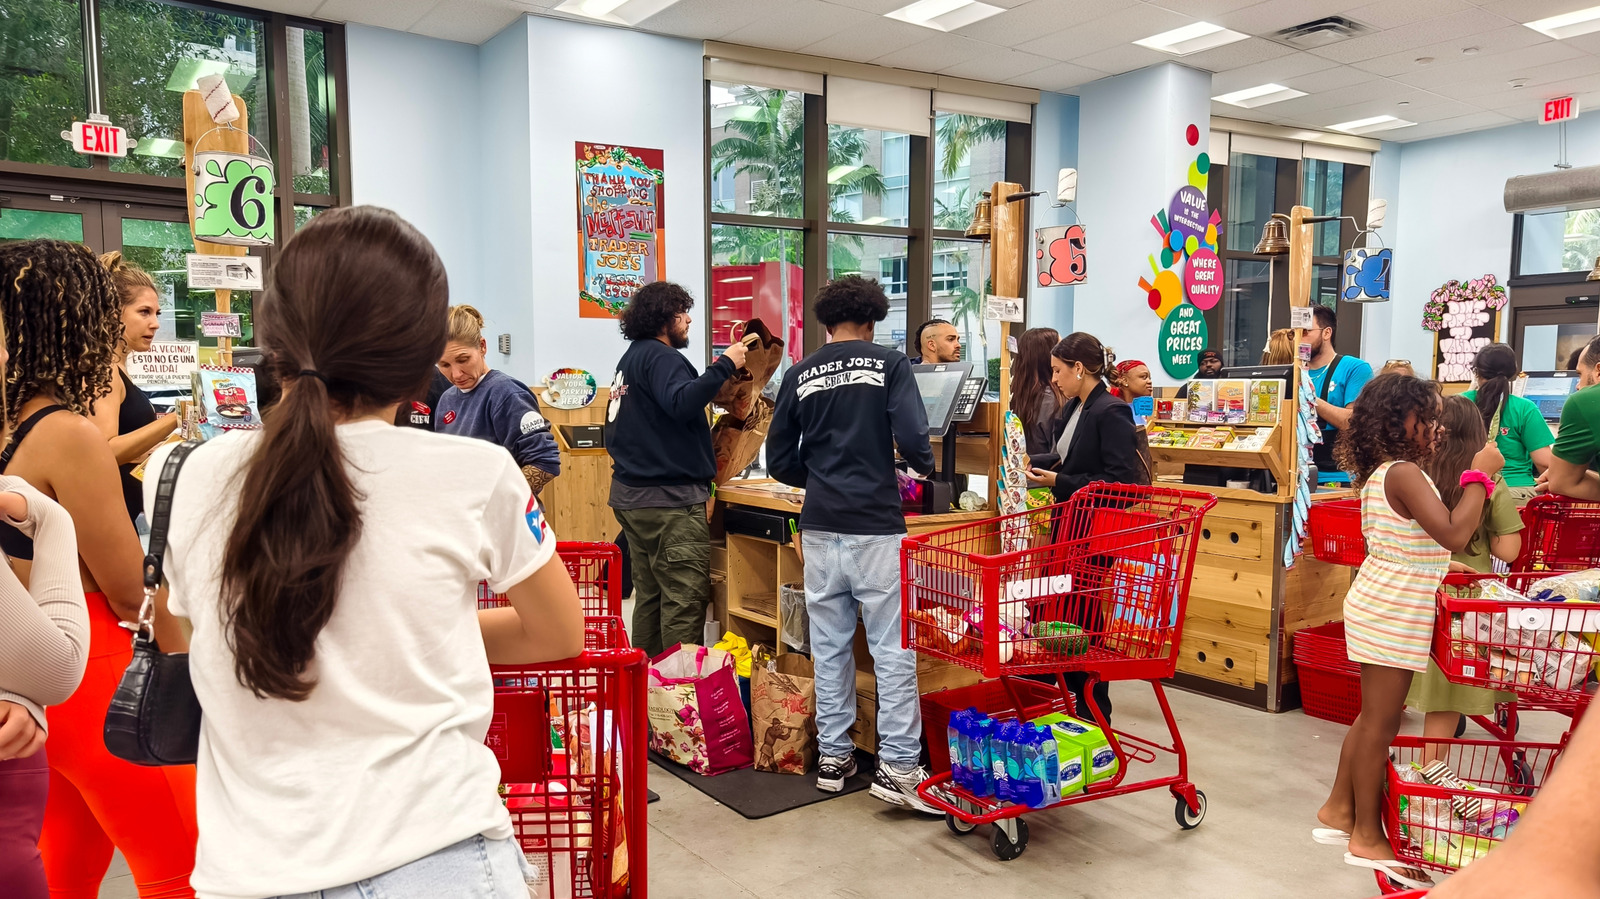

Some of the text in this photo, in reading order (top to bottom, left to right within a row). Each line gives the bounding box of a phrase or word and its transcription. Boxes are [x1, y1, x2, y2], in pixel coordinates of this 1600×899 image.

[1545, 97, 1573, 121] EXIT
[82, 124, 120, 154] EXIT
[630, 175, 654, 188] YOU
[590, 184, 648, 200] SHOPPING
[230, 176, 266, 230] 6
[1180, 190, 1206, 211] VALUE
[1184, 207, 1200, 220] IS THE
[1173, 214, 1205, 233] INTERSECTION
[588, 237, 650, 256] TRADER
[597, 253, 642, 271] JOE'S
[1069, 237, 1087, 276] 5
[1192, 257, 1217, 269] WHERE
[1194, 270, 1215, 281] GREAT
[1373, 258, 1391, 291] 4
[1191, 284, 1220, 295] QUALITY
[1179, 307, 1194, 318] AND
[1447, 298, 1486, 314] DON'T
[1170, 320, 1201, 335] GREAT
[1442, 312, 1490, 328] FORGET
[1449, 326, 1473, 340] TO
[159, 345, 191, 354] VECINO!
[1166, 336, 1203, 351] PRICES
[132, 355, 196, 364] ESTO NO ES UNA
[1172, 353, 1192, 366] MEET.
[142, 364, 178, 373] SALIDA!
[797, 357, 885, 384] TRADER JOE'S
[824, 372, 852, 388] CREW
[561, 388, 594, 396] PARKING
[561, 397, 587, 406] HERE!
[410, 414, 430, 424] CREW
